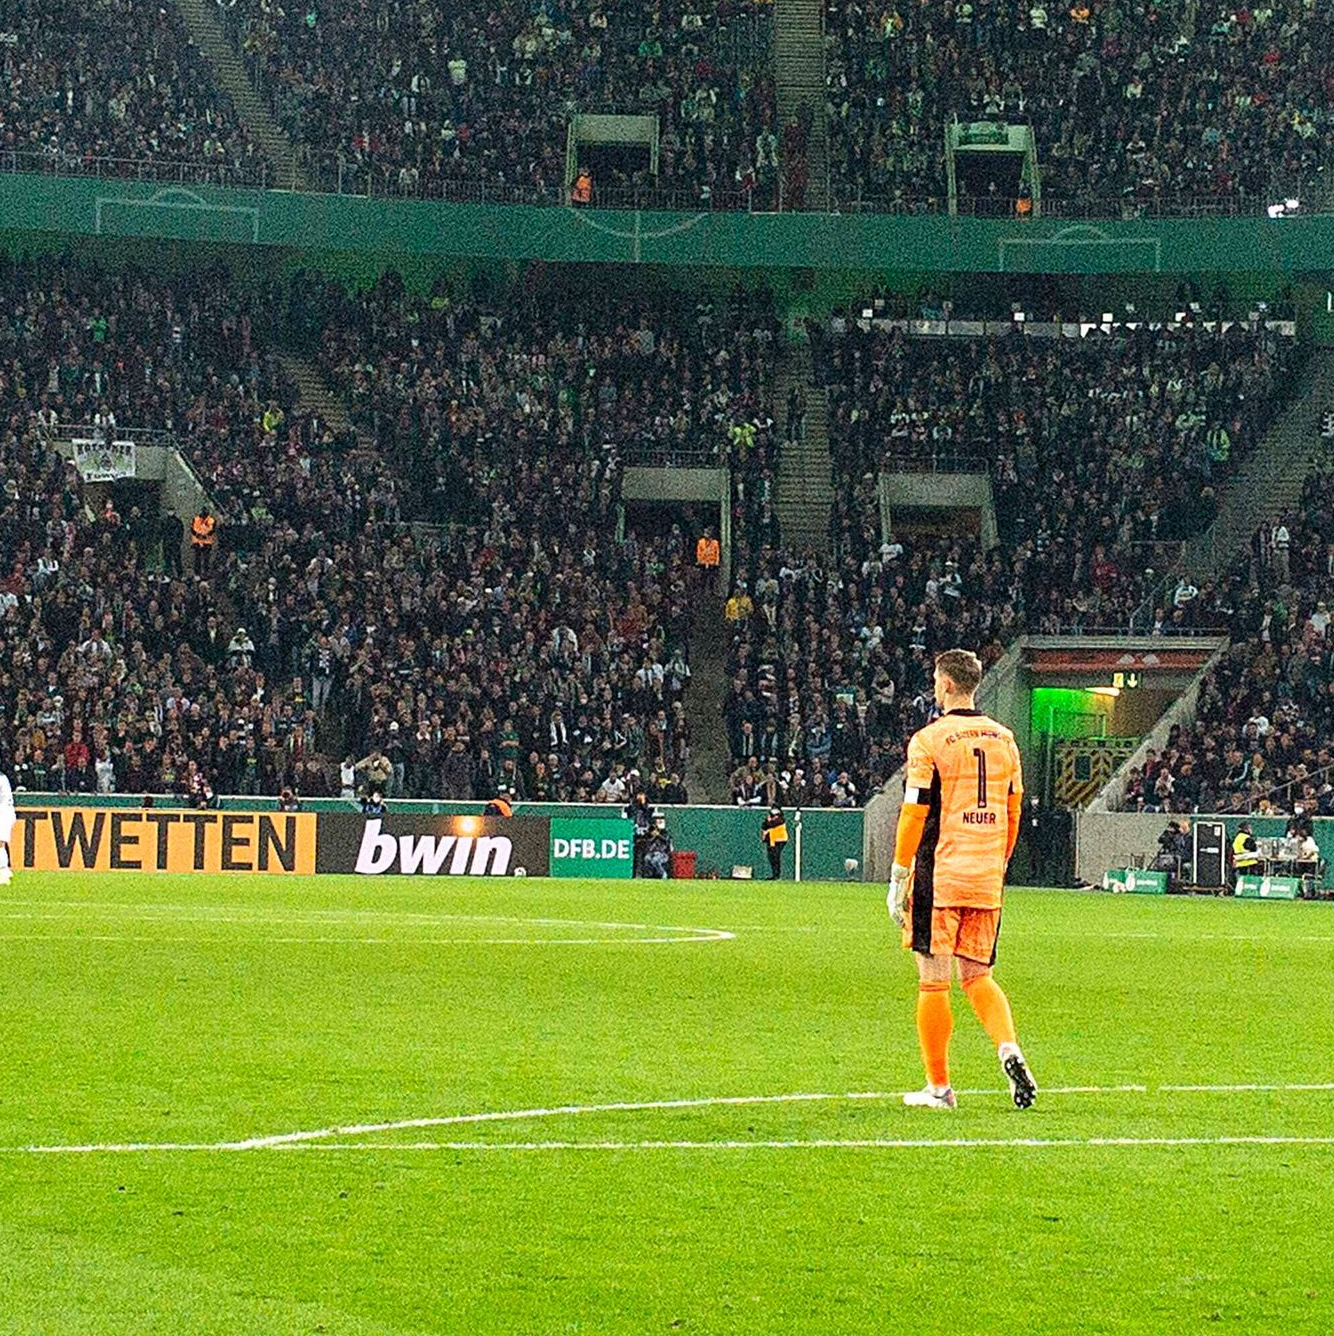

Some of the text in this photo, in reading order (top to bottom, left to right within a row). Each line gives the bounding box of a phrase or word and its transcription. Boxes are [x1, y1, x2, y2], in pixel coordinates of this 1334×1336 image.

[973, 747, 987, 809] 1
[962, 811, 997, 825] NEUER
[354, 817, 513, 876] bwin
[553, 838, 630, 859] DFB.DE
